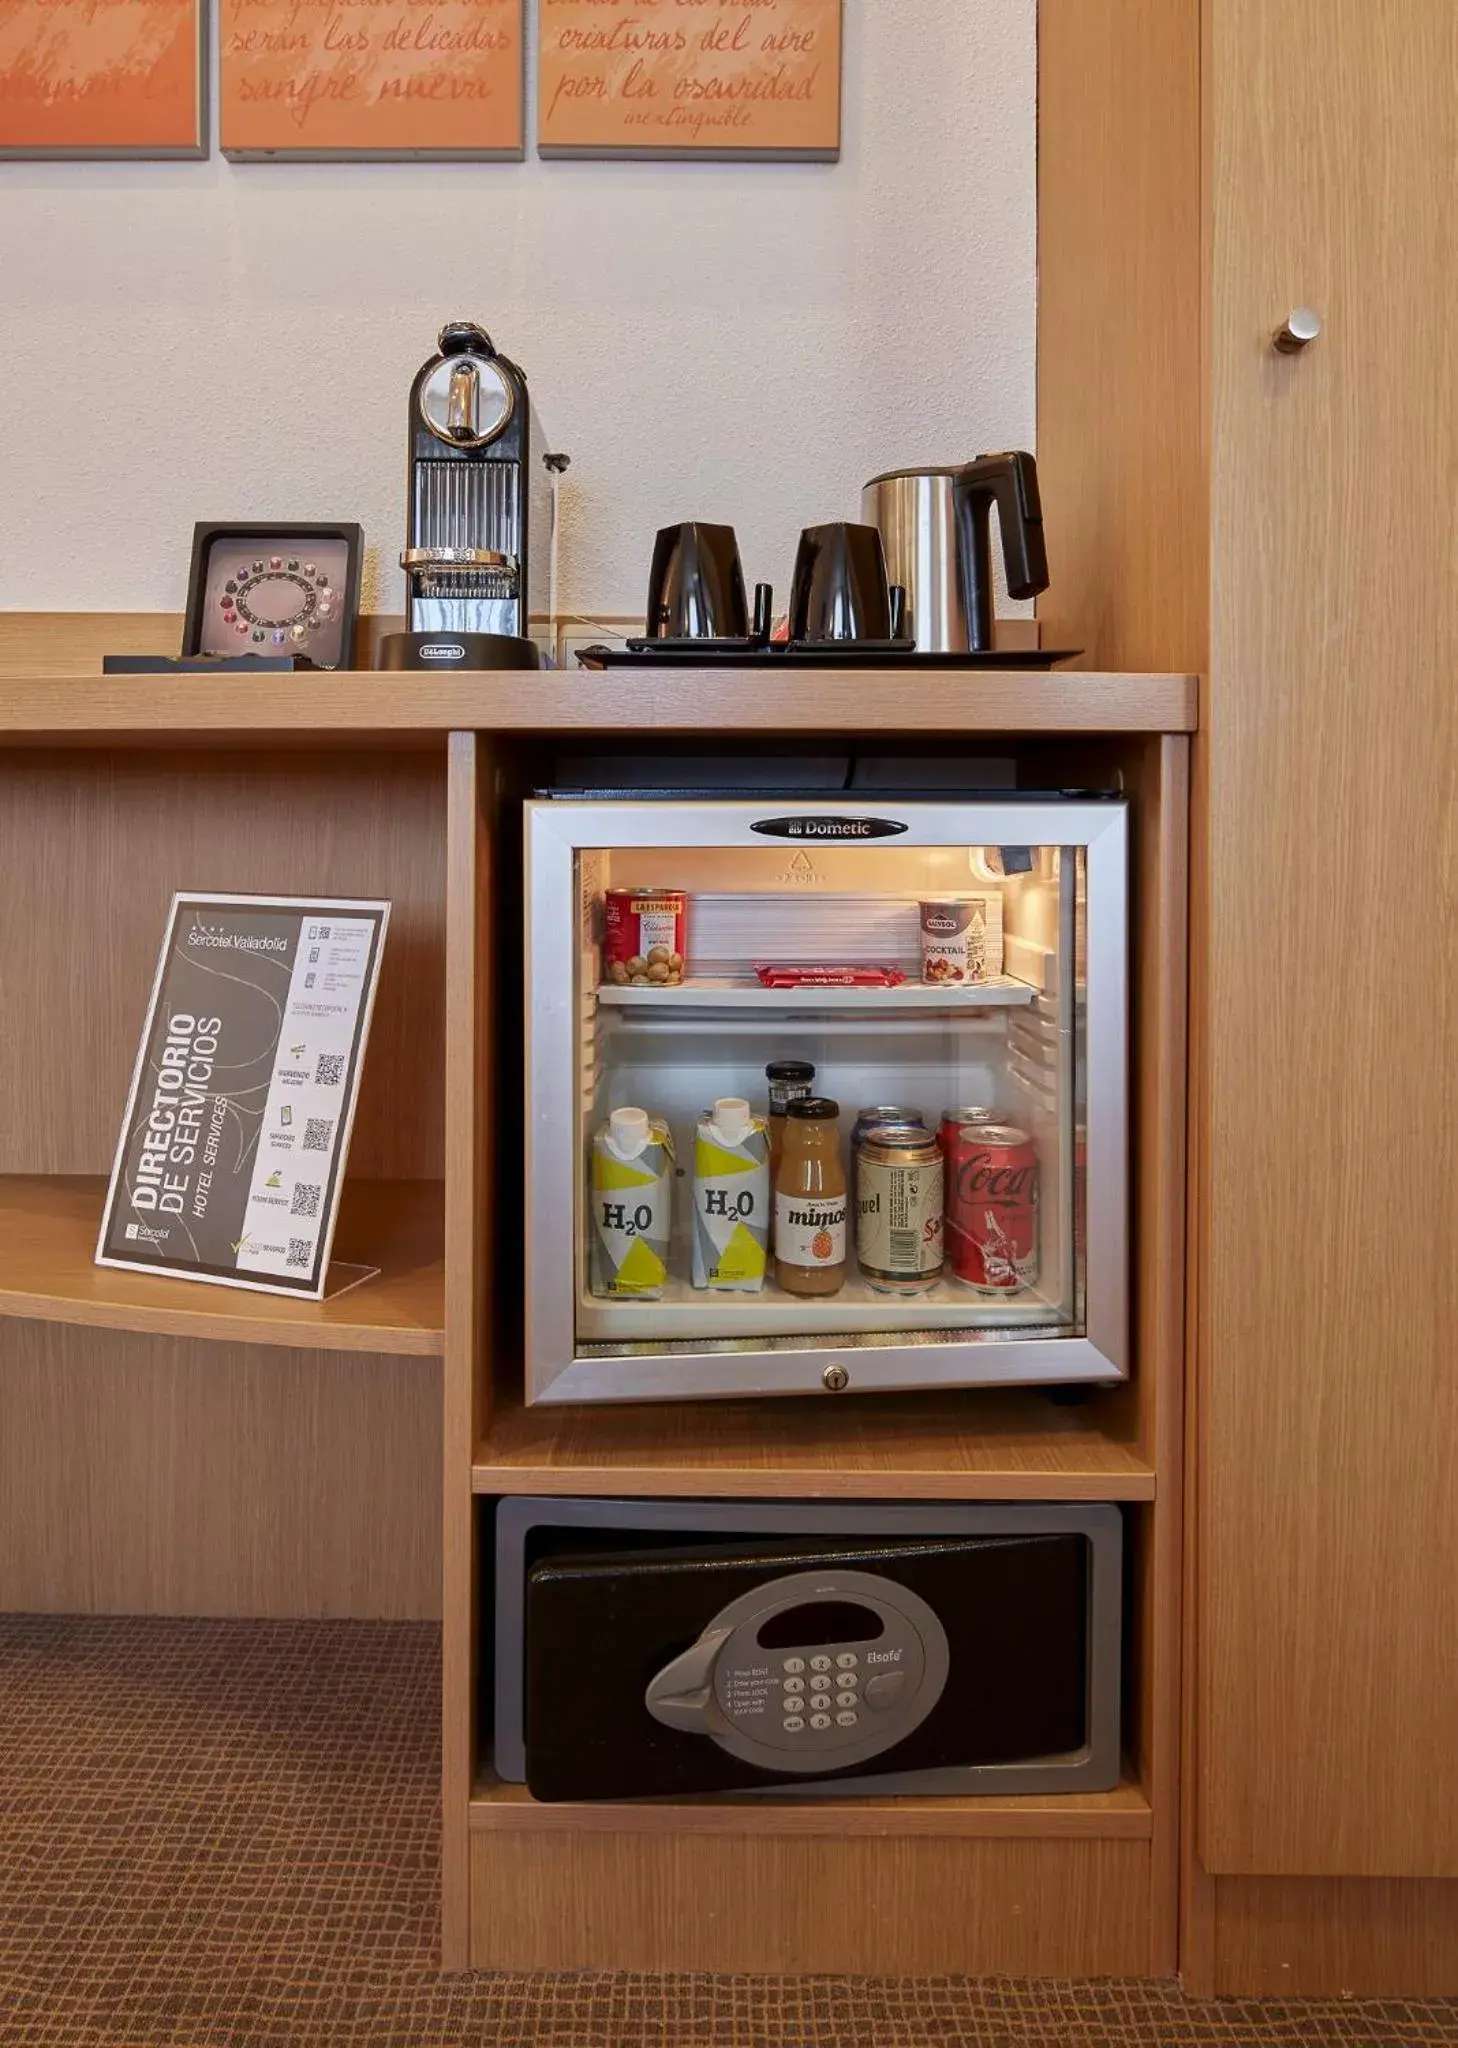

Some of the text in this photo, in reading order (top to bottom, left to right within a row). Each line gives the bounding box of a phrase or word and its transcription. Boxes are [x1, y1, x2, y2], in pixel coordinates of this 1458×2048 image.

[323, 15, 369, 50] las
[382, 13, 511, 50] delicadas
[558, 15, 814, 54] criaturas del aire
[239, 74, 359, 129] sangre
[547, 59, 822, 121] por la oscuridad
[805, 821, 871, 835] Dometic
[926, 945, 966, 954] COCKTAIL
[131, 1013, 196, 1211] DIRECTORIO
[159, 1016, 222, 1214] DE SERVICIOS
[192, 1095, 229, 1219] HOTEL SERVICES
[602, 1202, 653, 1237] H2O
[704, 1189, 755, 1222] H2O
[867, 1649, 901, 1664] Elsafe
